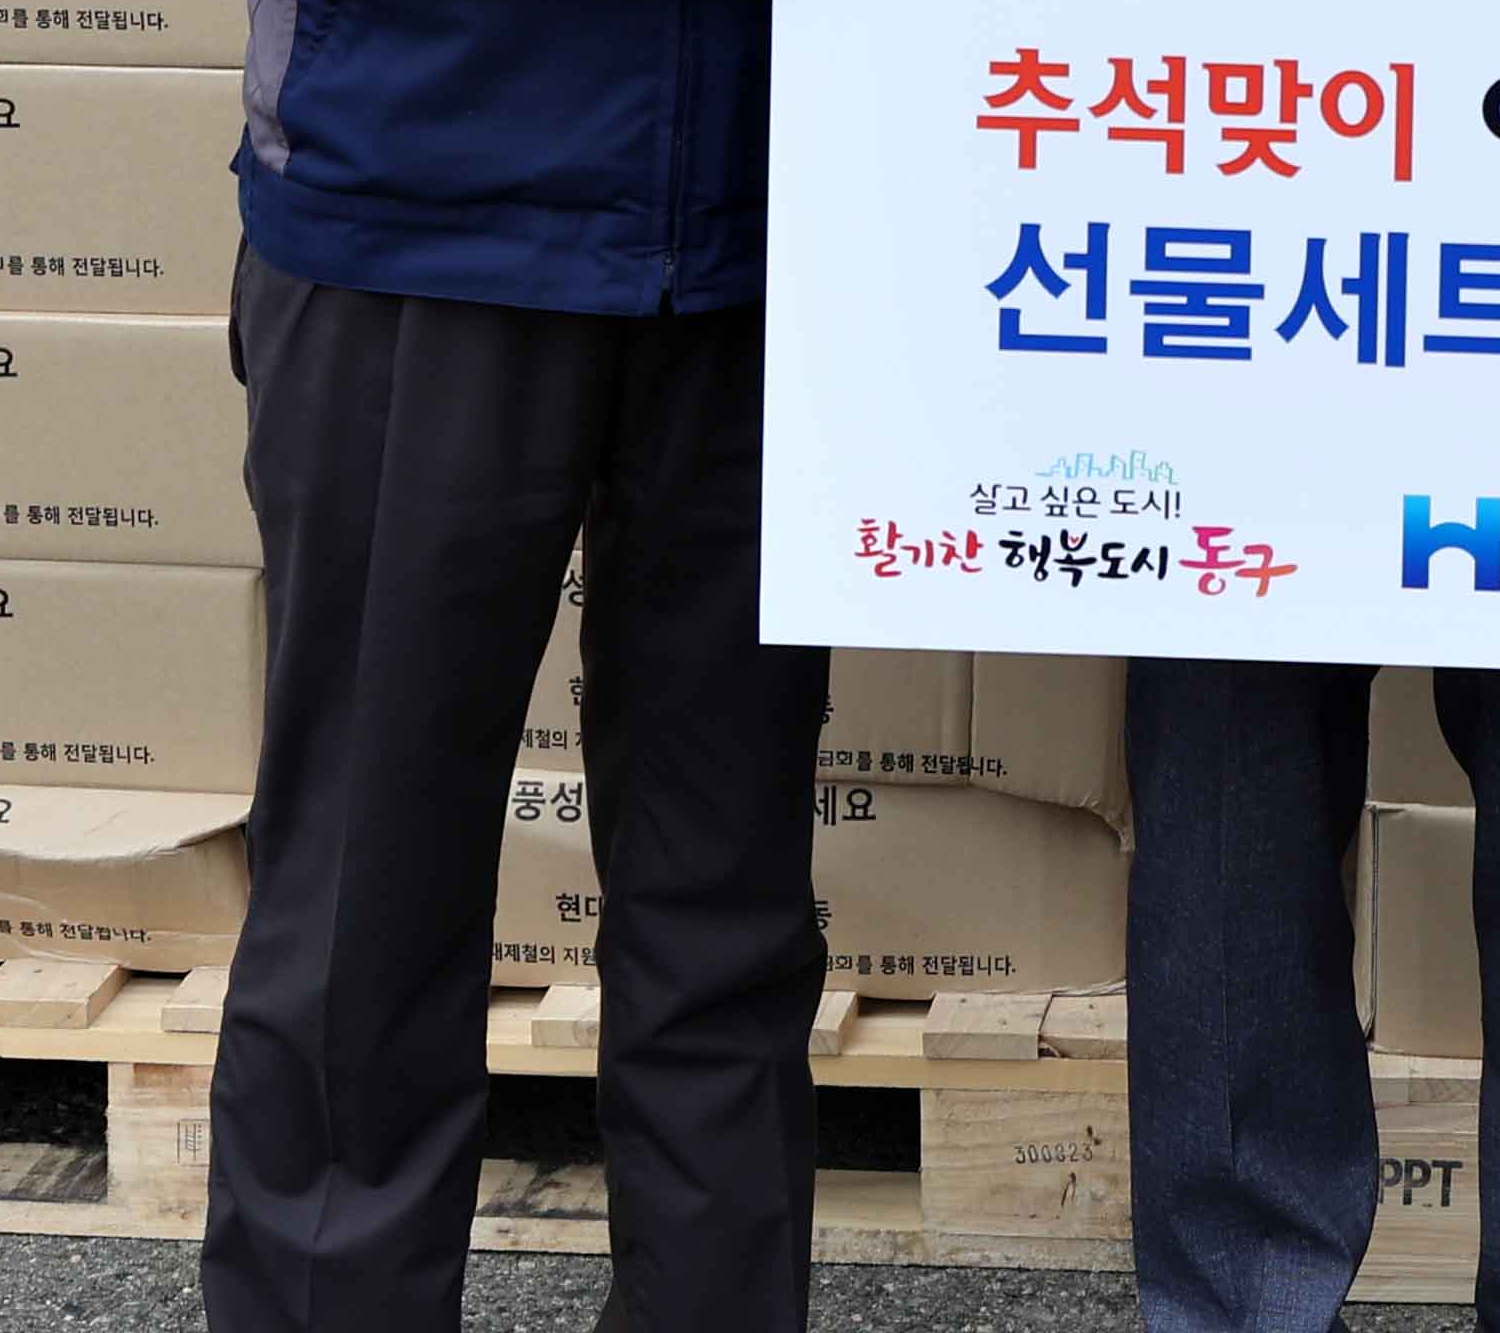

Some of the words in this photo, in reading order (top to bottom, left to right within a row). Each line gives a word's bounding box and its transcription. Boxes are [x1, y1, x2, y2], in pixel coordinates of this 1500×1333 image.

[35, 8, 70, 30] 통해
[76, 9, 169, 32] 전달됩니다.
[976, 47, 1415, 182] 추석맞이
[969, 482, 1032, 516] 살고
[1039, 484, 1102, 520] 싶은
[1109, 488, 1181, 521] 도시!
[853, 518, 985, 579] 활기찬
[997, 528, 1170, 589] 행복도시
[1177, 525, 1299, 598] 동구
[1379, 1156, 1464, 1208] PPT
